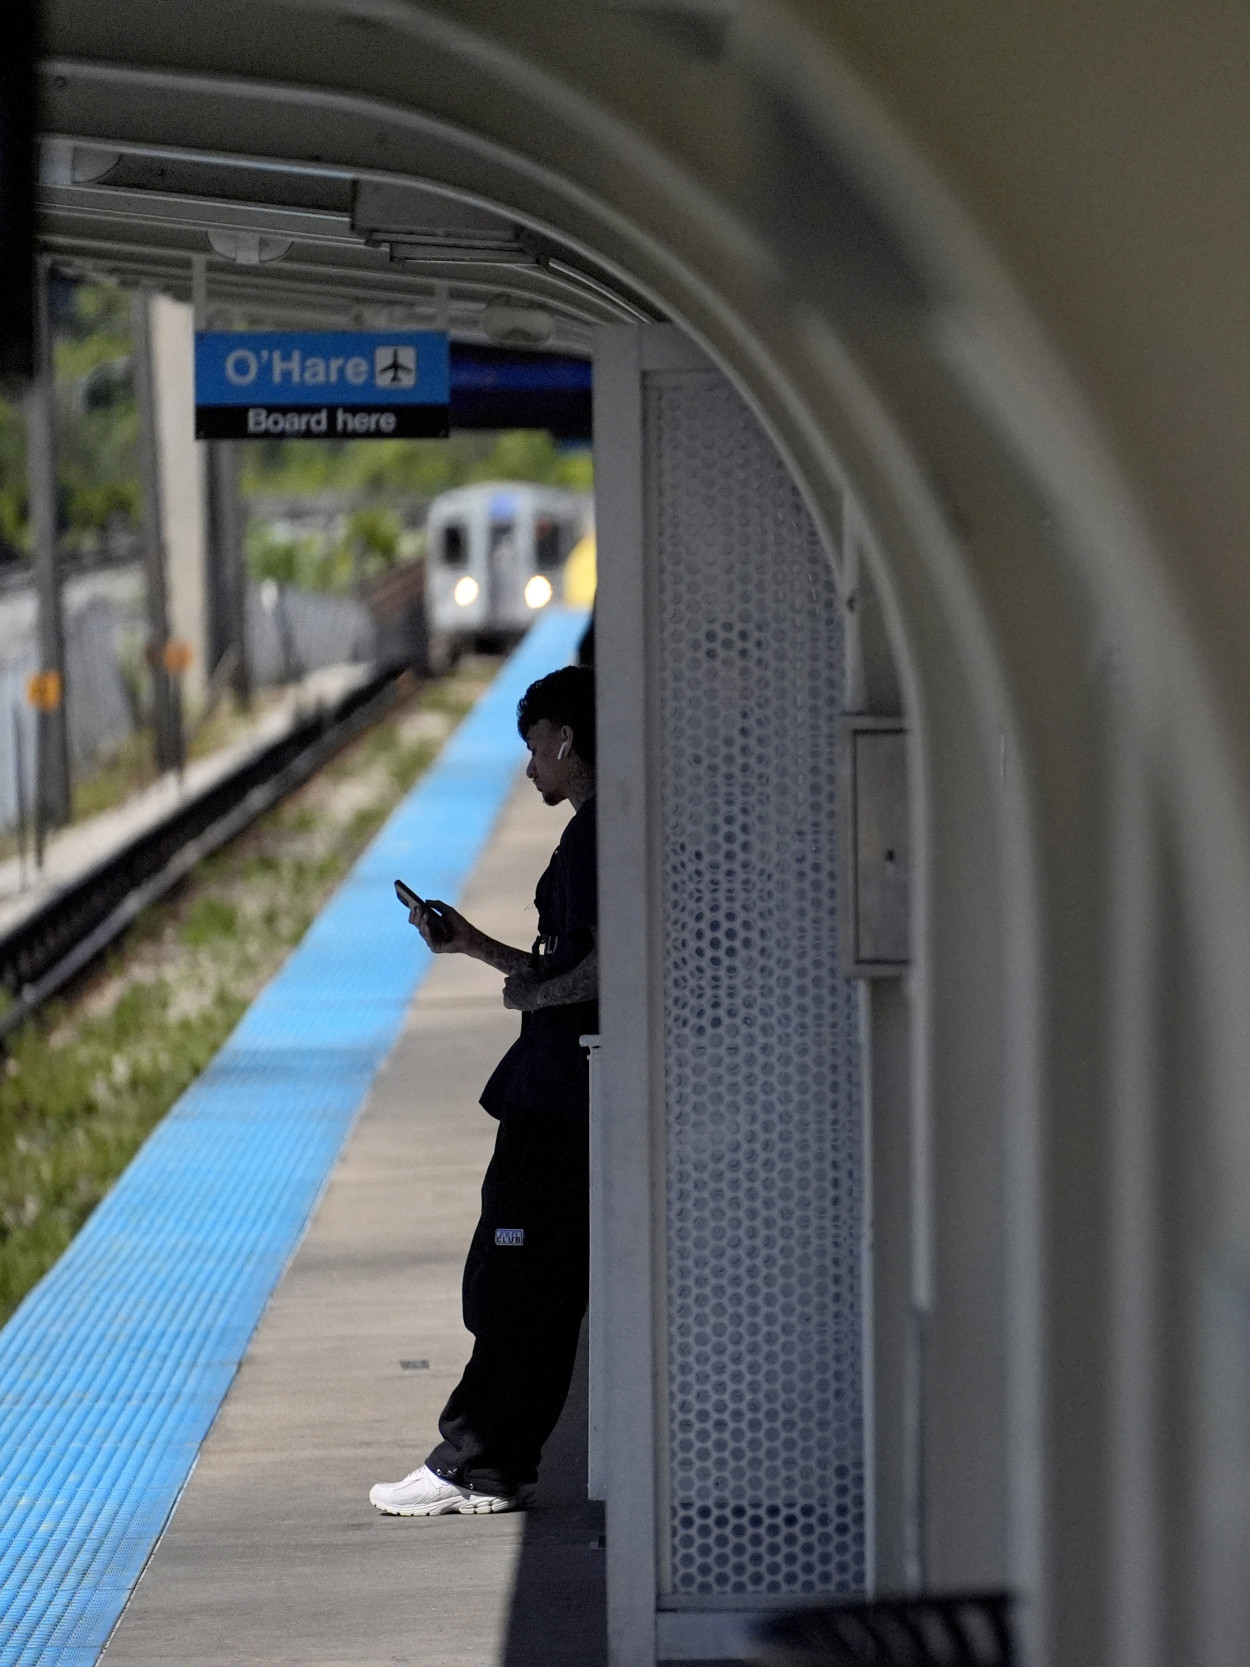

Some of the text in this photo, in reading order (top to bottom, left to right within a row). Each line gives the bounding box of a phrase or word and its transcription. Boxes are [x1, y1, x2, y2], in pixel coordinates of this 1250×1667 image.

[224, 348, 369, 386] O'Hare
[248, 407, 397, 433] Board here
